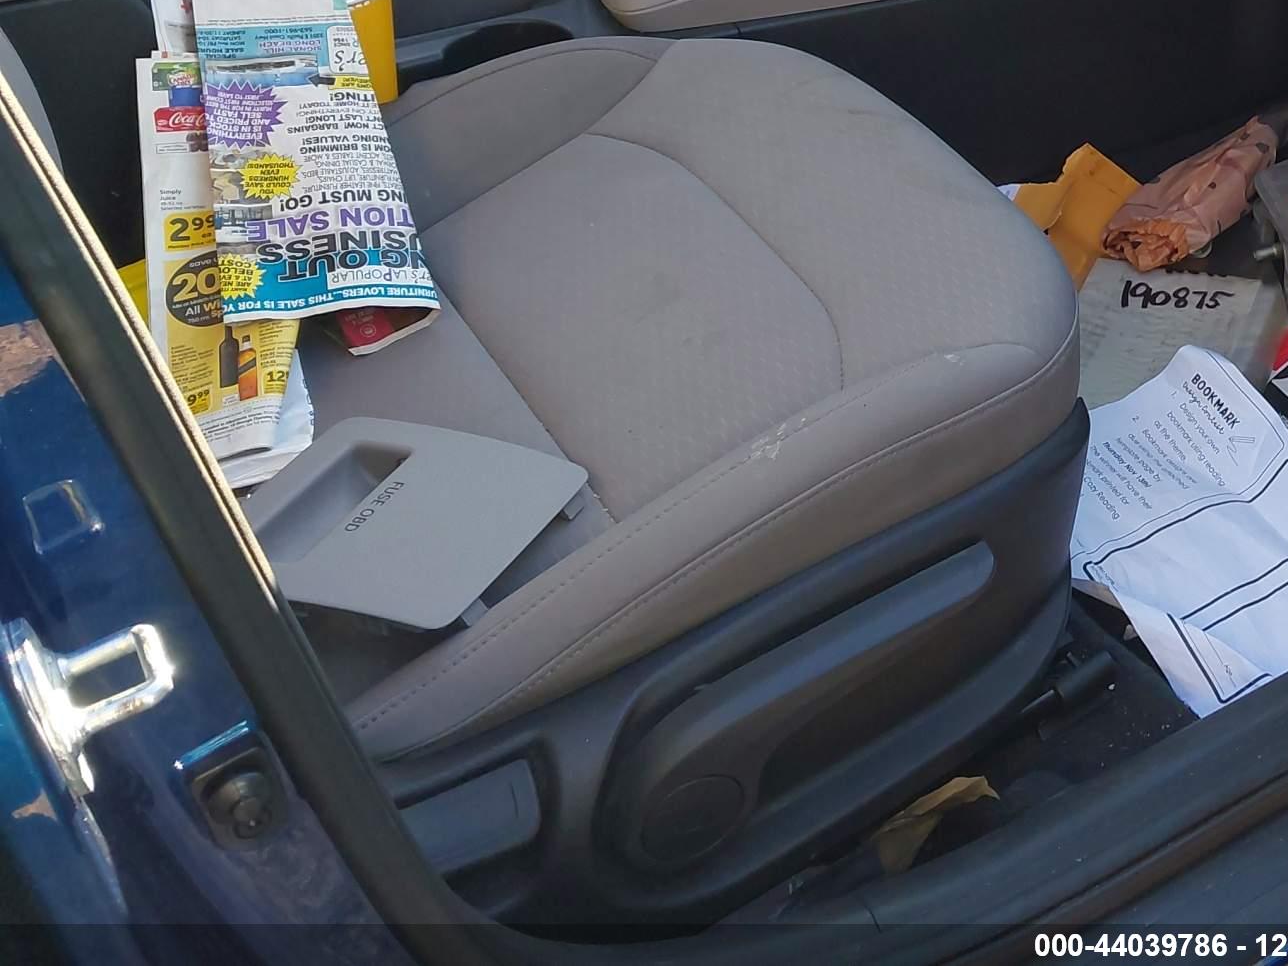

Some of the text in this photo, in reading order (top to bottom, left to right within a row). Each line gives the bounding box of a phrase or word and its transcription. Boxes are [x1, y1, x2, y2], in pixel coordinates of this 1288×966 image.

[213, 108, 262, 119] SELL FAST!
[305, 114, 363, 124] LAST LONG!
[209, 121, 240, 132] STOCK
[217, 116, 250, 126] PRICED
[251, 118, 271, 126] AND
[287, 122, 339, 134] BARGAINS
[302, 135, 350, 145] VALUES!
[299, 143, 358, 155] BRIMMING
[331, 152, 354, 160] TABLES
[319, 166, 359, 175] ADJUSTABLE
[279, 194, 313, 211] GO!
[318, 189, 372, 204] MUST
[246, 210, 330, 243] SALE
[279, 250, 367, 282] OUT
[1121, 280, 1235, 309] 190875
[185, 304, 200, 316] All
[238, 301, 261, 311] FOR
[264, 300, 275, 309] IS
[276, 298, 306, 309] SALE
[266, 370, 289, 382] 12
[1191, 373, 1240, 429] BOOKMARK
[1154, 420, 1161, 429] as
[1160, 427, 1170, 440] the
[1179, 402, 1198, 425] Design
[1194, 422, 1208, 439] your
[1206, 438, 1220, 455] own
[1142, 429, 1167, 458] Bookmark
[1167, 411, 1225, 487] bookmark using reading
[1102, 441, 1137, 476] Thursday Nov
[1138, 459, 1154, 475] page
[1153, 473, 1161, 483] by
[1124, 479, 1140, 496] have
[344, 482, 405, 532] FUSE OBD
[1096, 491, 1120, 520] Reading
